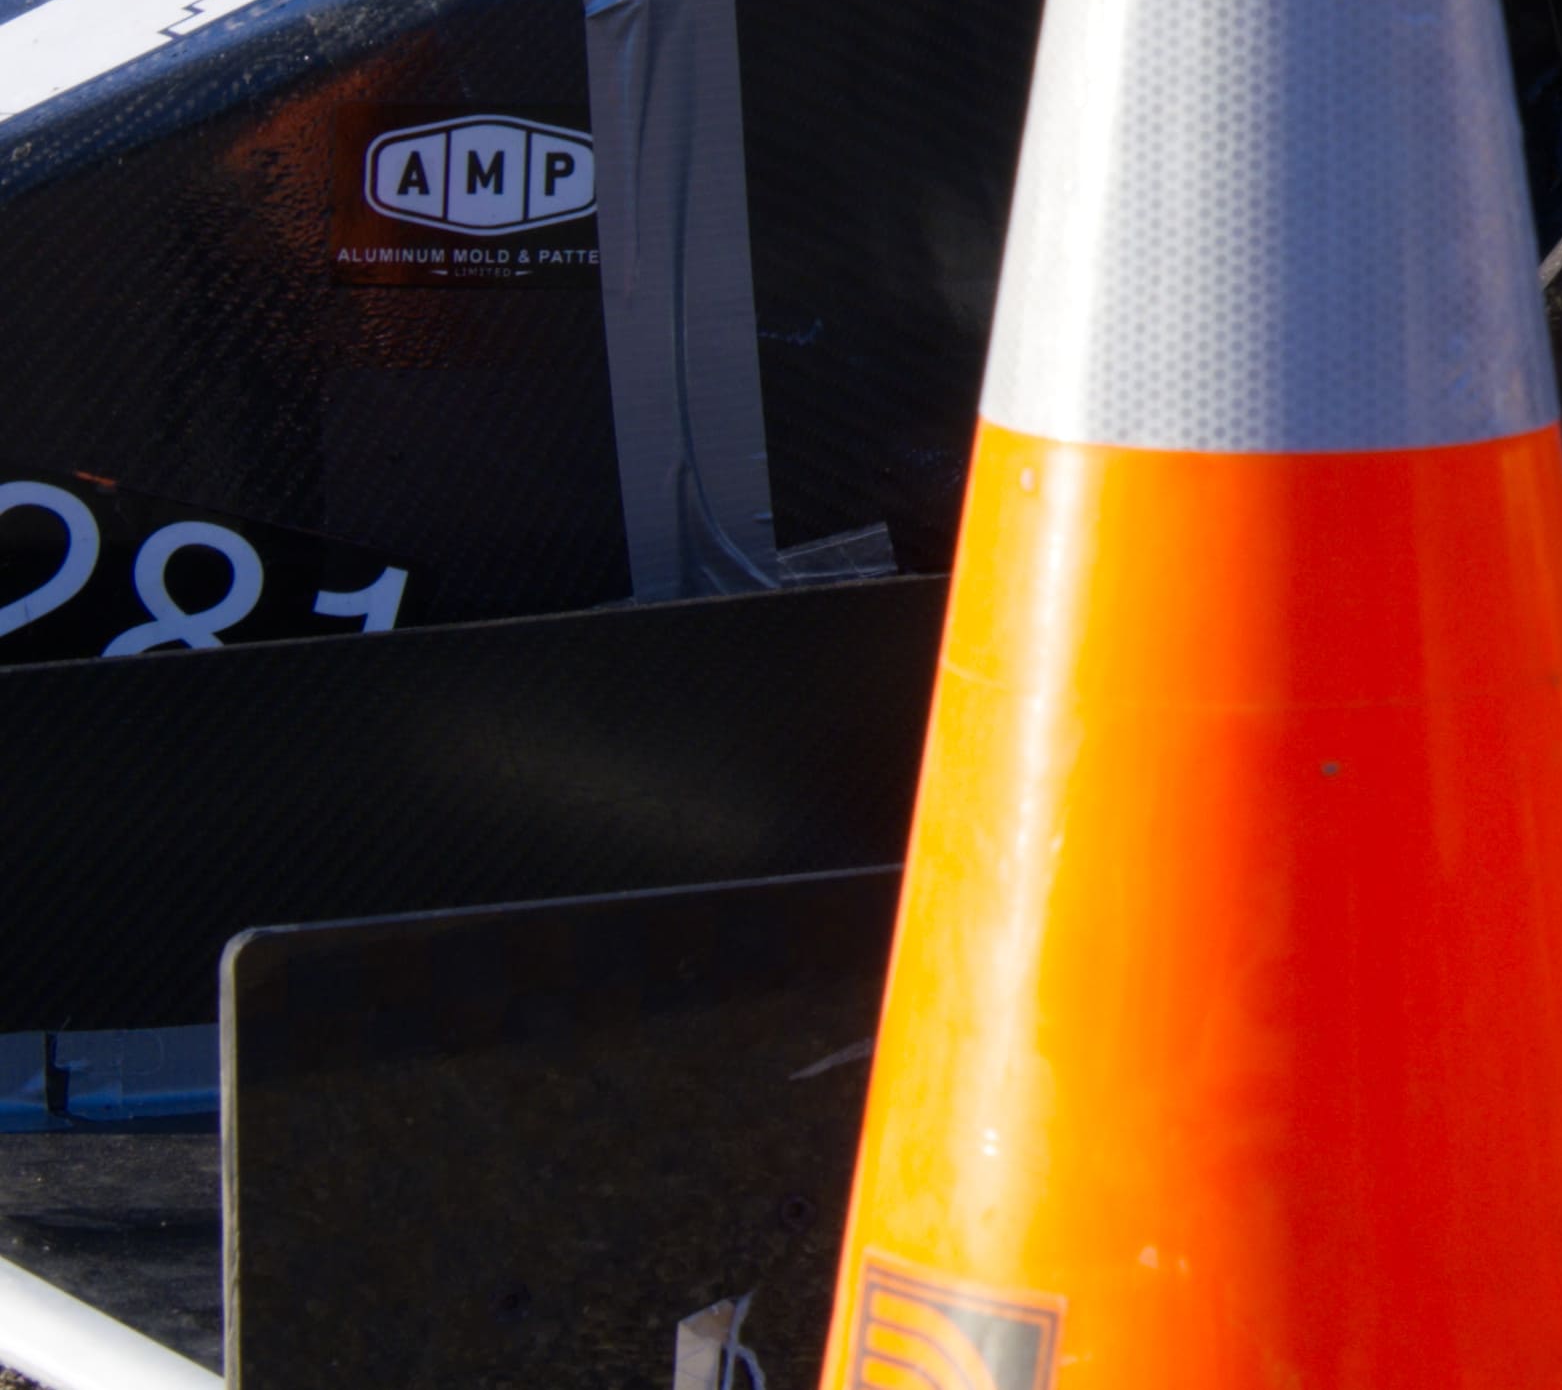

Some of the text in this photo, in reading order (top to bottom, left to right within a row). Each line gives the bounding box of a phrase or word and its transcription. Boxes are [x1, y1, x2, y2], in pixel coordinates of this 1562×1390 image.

[397, 150, 575, 197] AMP
[337, 248, 599, 266] ALUMINUM MOLD & PATTE
[454, 266, 512, 278] LIMITED
